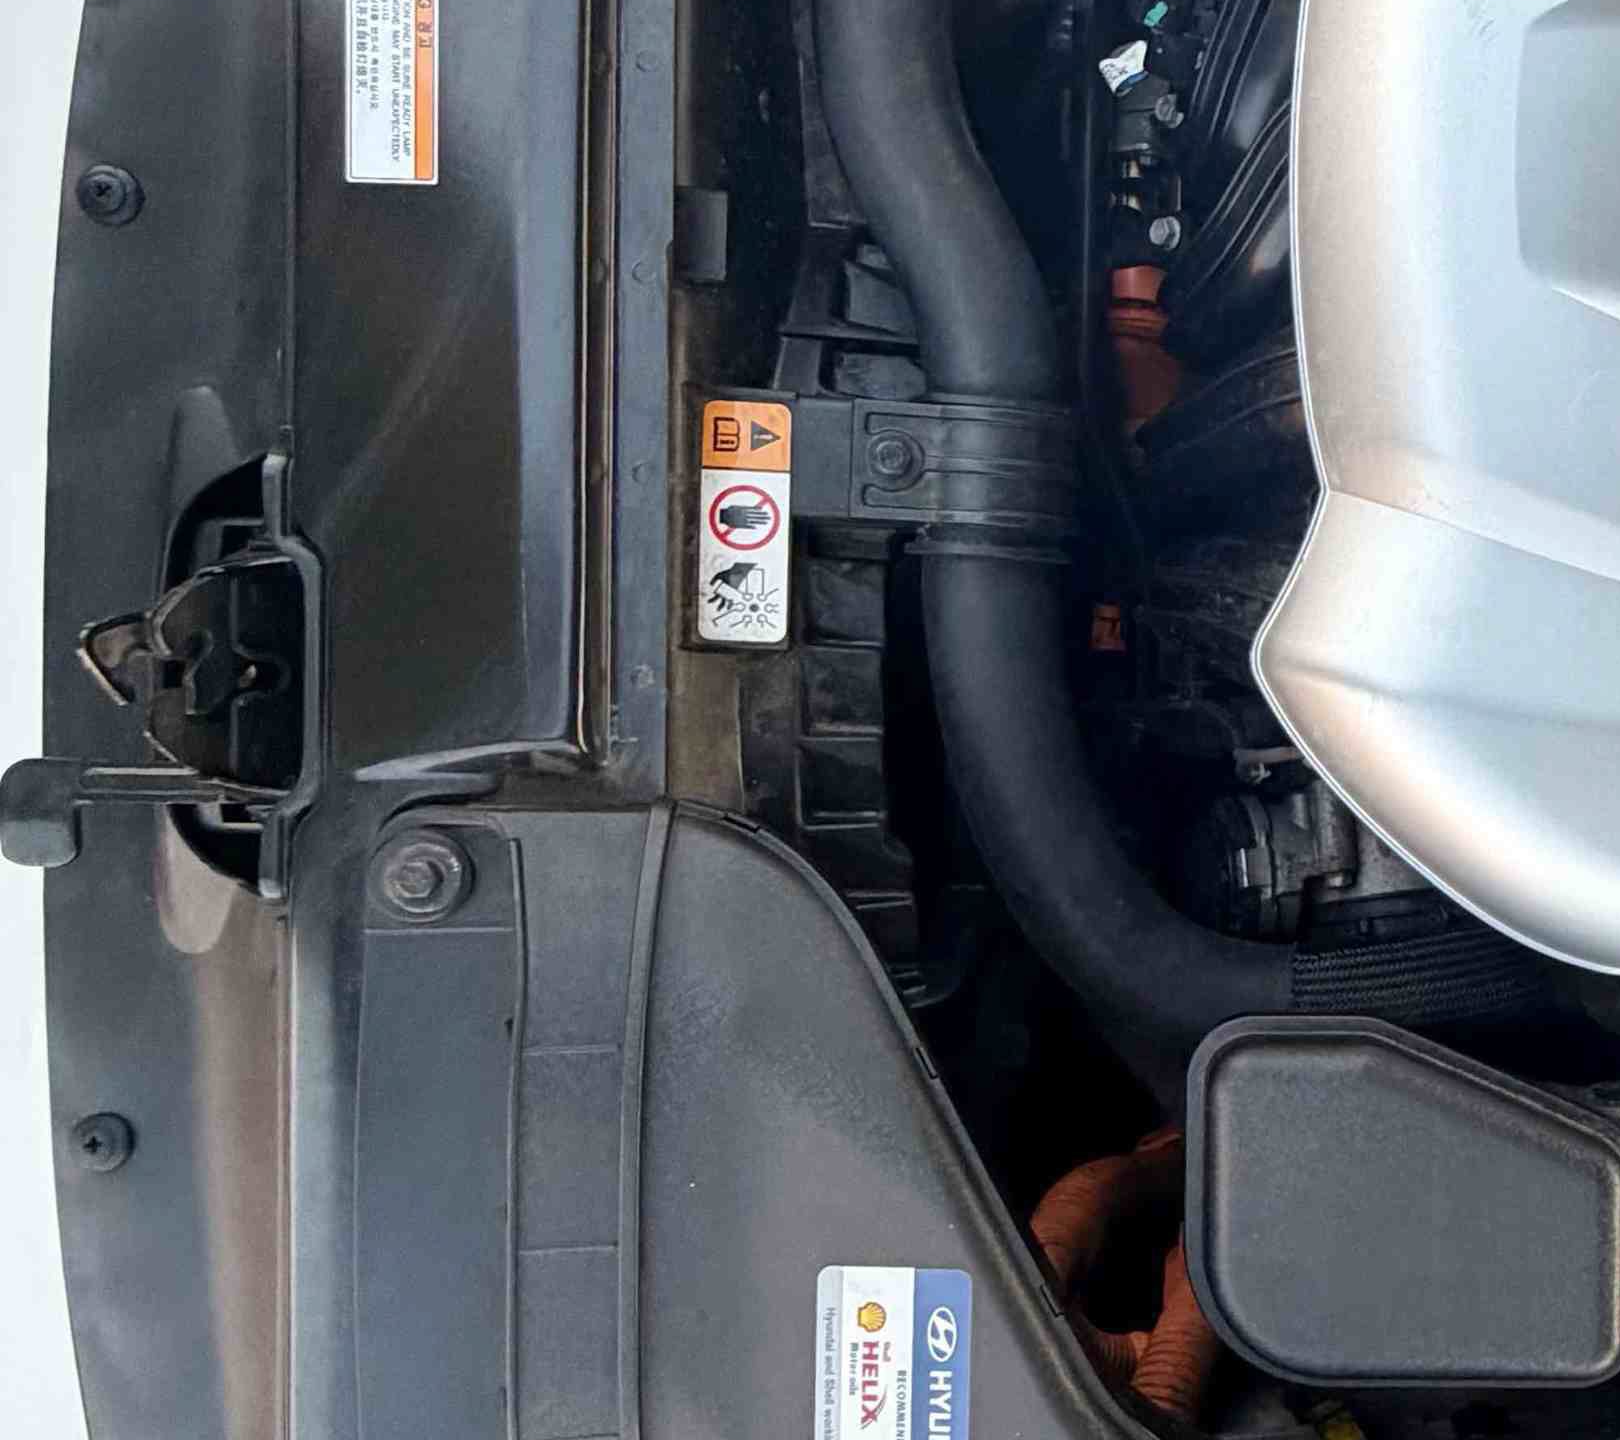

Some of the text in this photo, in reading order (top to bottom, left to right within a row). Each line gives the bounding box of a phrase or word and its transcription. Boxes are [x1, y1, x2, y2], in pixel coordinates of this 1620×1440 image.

[823, 1307, 837, 1352] Hyundai
[825, 1355, 836, 1376] and
[860, 1341, 879, 1425] HELIX
[824, 1378, 836, 1406] Shell
